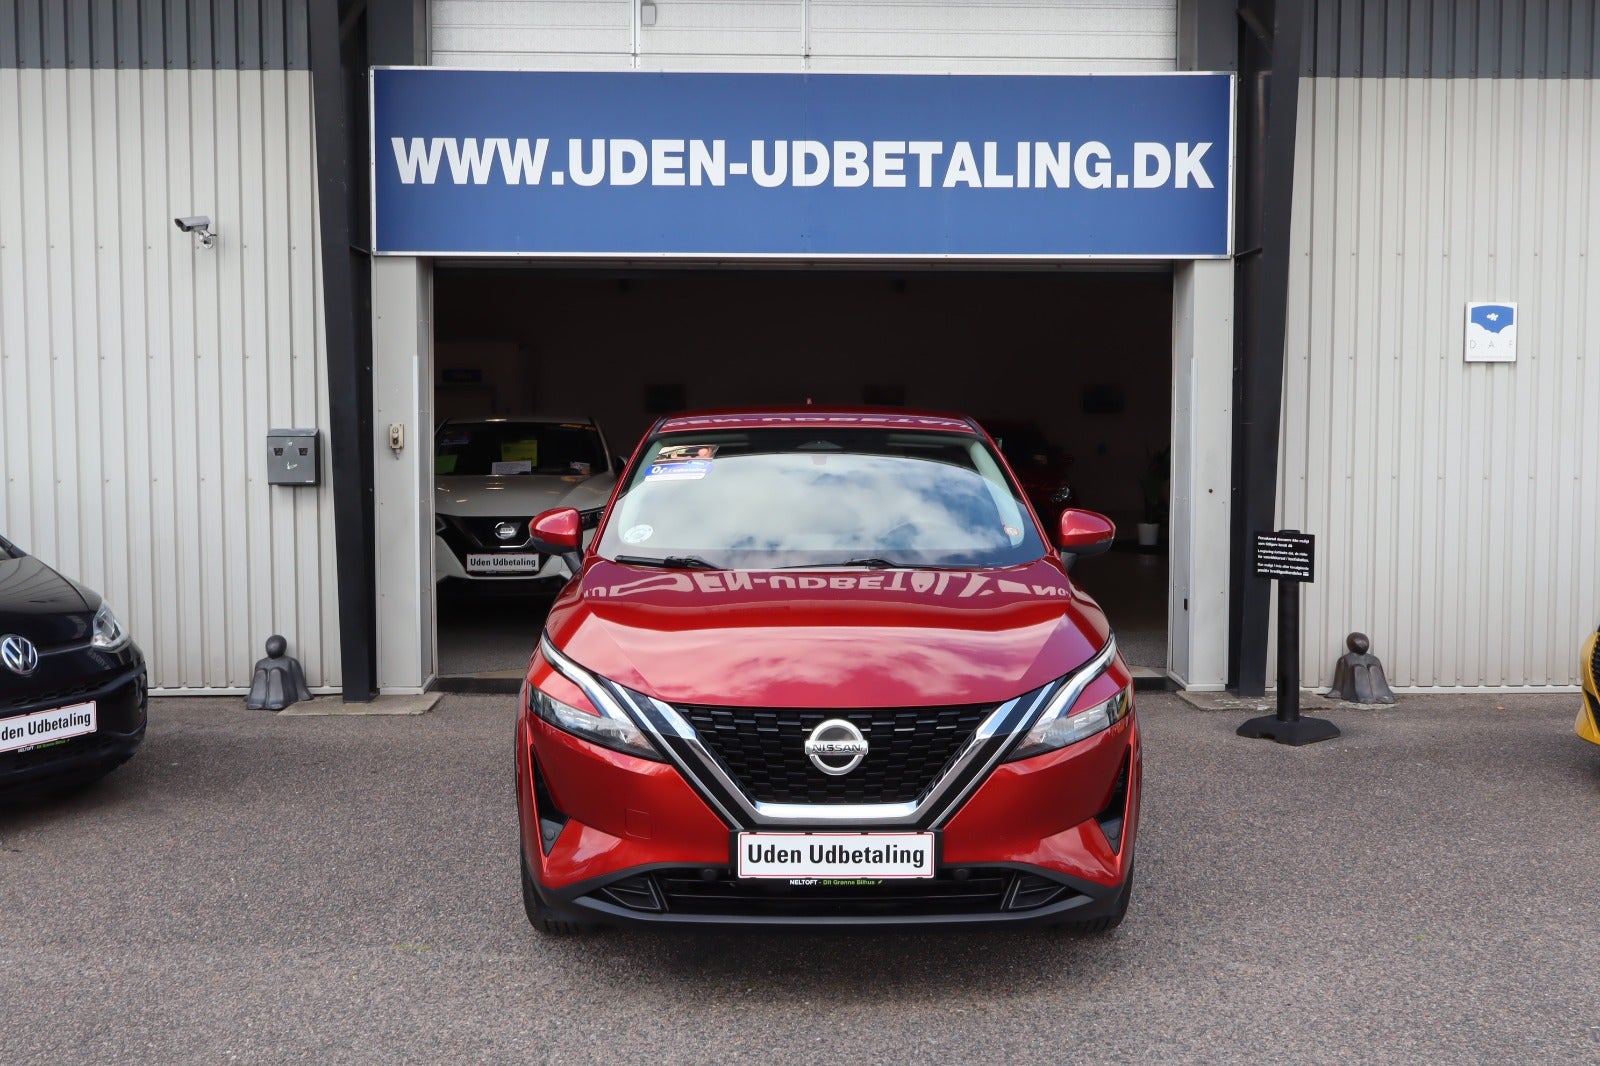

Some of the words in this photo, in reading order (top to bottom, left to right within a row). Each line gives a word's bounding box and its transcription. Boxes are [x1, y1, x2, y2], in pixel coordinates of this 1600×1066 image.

[391, 137, 1215, 190] WWW.UDEN-UDBETALING.DK
[470, 557, 491, 567] Uden
[492, 557, 536, 568] Udbetaling
[1, 726, 24, 741] den
[28, 712, 91, 736] Udbetaling
[812, 744, 861, 752] NISSAN
[748, 844, 802, 865] Uden
[809, 844, 925, 868] Udbetaling
